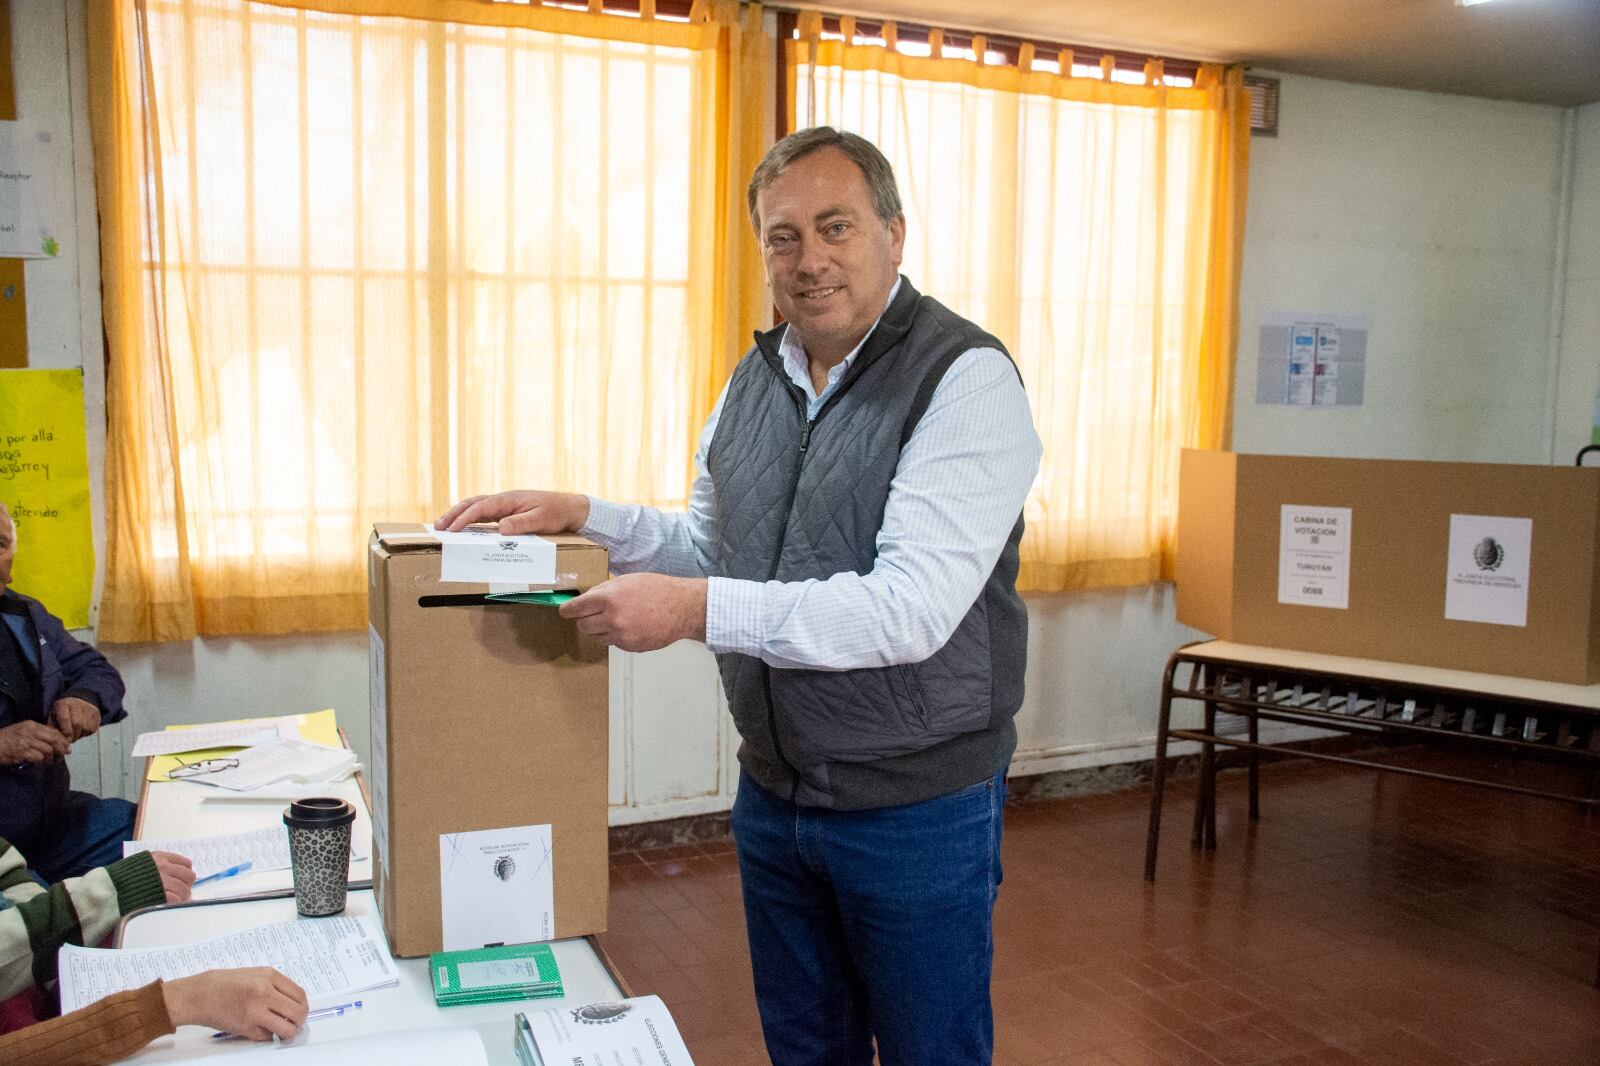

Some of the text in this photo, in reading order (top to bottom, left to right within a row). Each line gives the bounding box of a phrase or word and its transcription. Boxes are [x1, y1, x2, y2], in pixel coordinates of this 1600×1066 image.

[7, 435, 25, 448] por
[1294, 516, 1324, 524] CABINA
[644, 1018, 663, 1049] ELECCIONES
